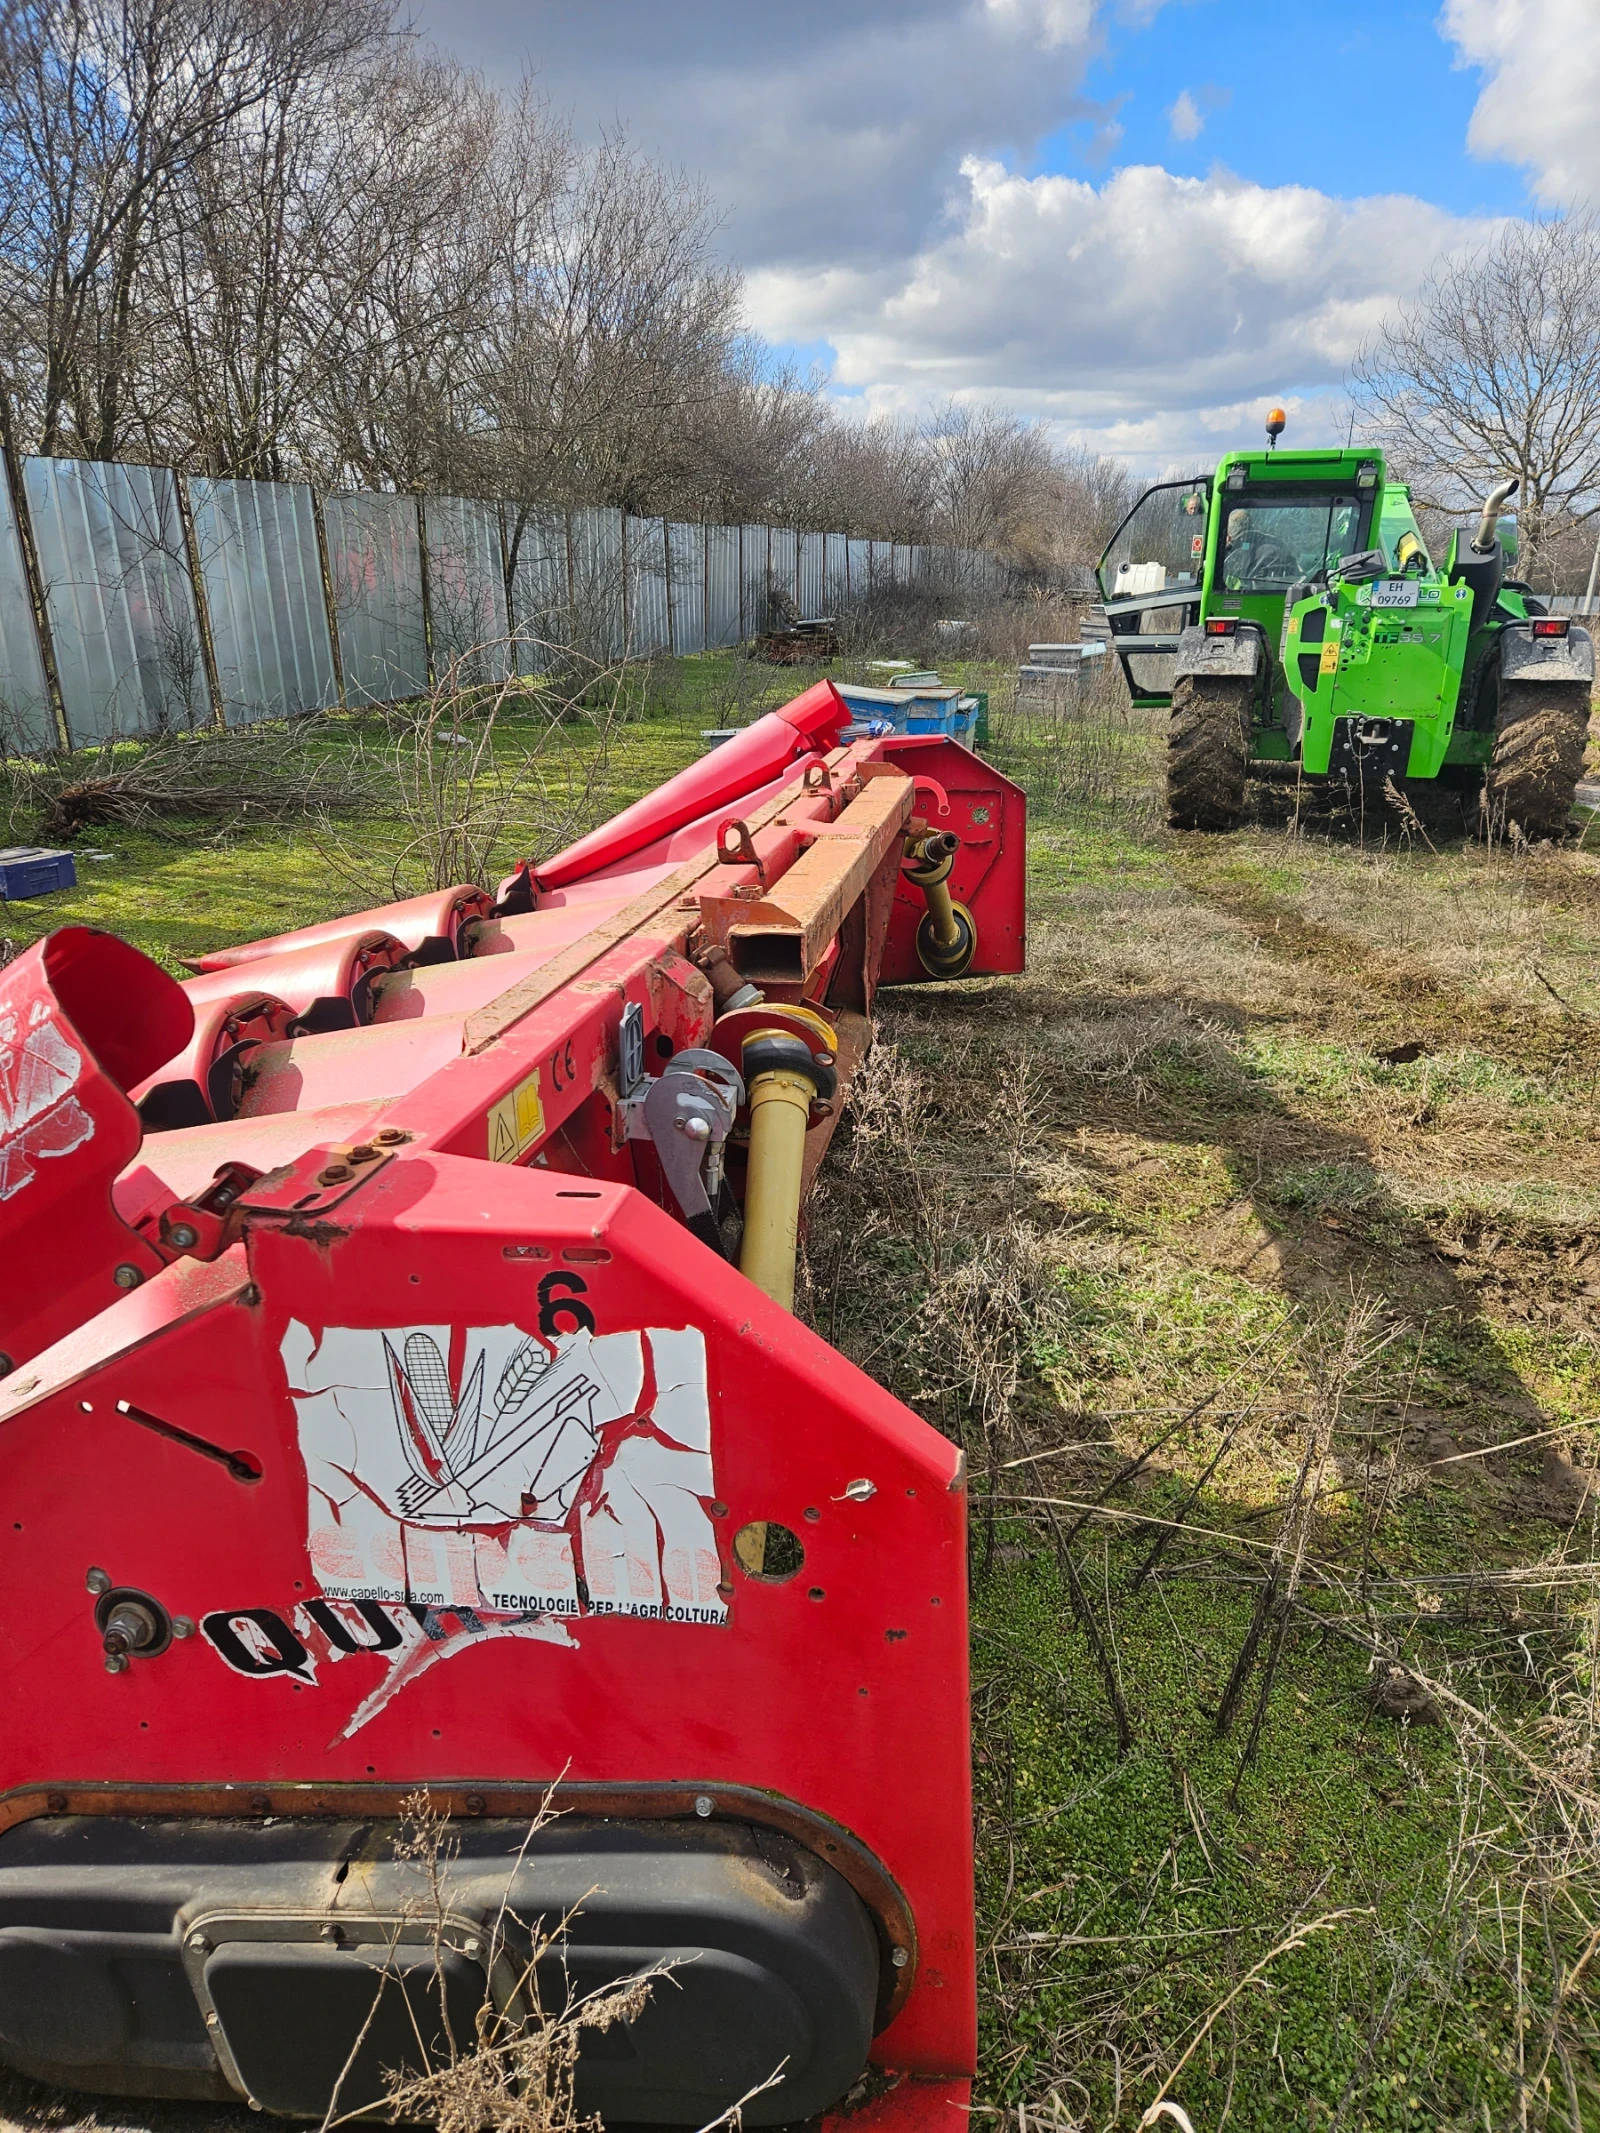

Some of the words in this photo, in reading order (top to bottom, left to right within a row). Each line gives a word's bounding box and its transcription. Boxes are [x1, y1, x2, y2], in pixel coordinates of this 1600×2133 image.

[1389, 582, 1404, 592] EH
[1377, 595, 1411, 605] 09769
[537, 1271, 595, 1337] 6
[493, 1593, 578, 1613] TECNOLOGIE
[587, 1600, 614, 1614] PER
